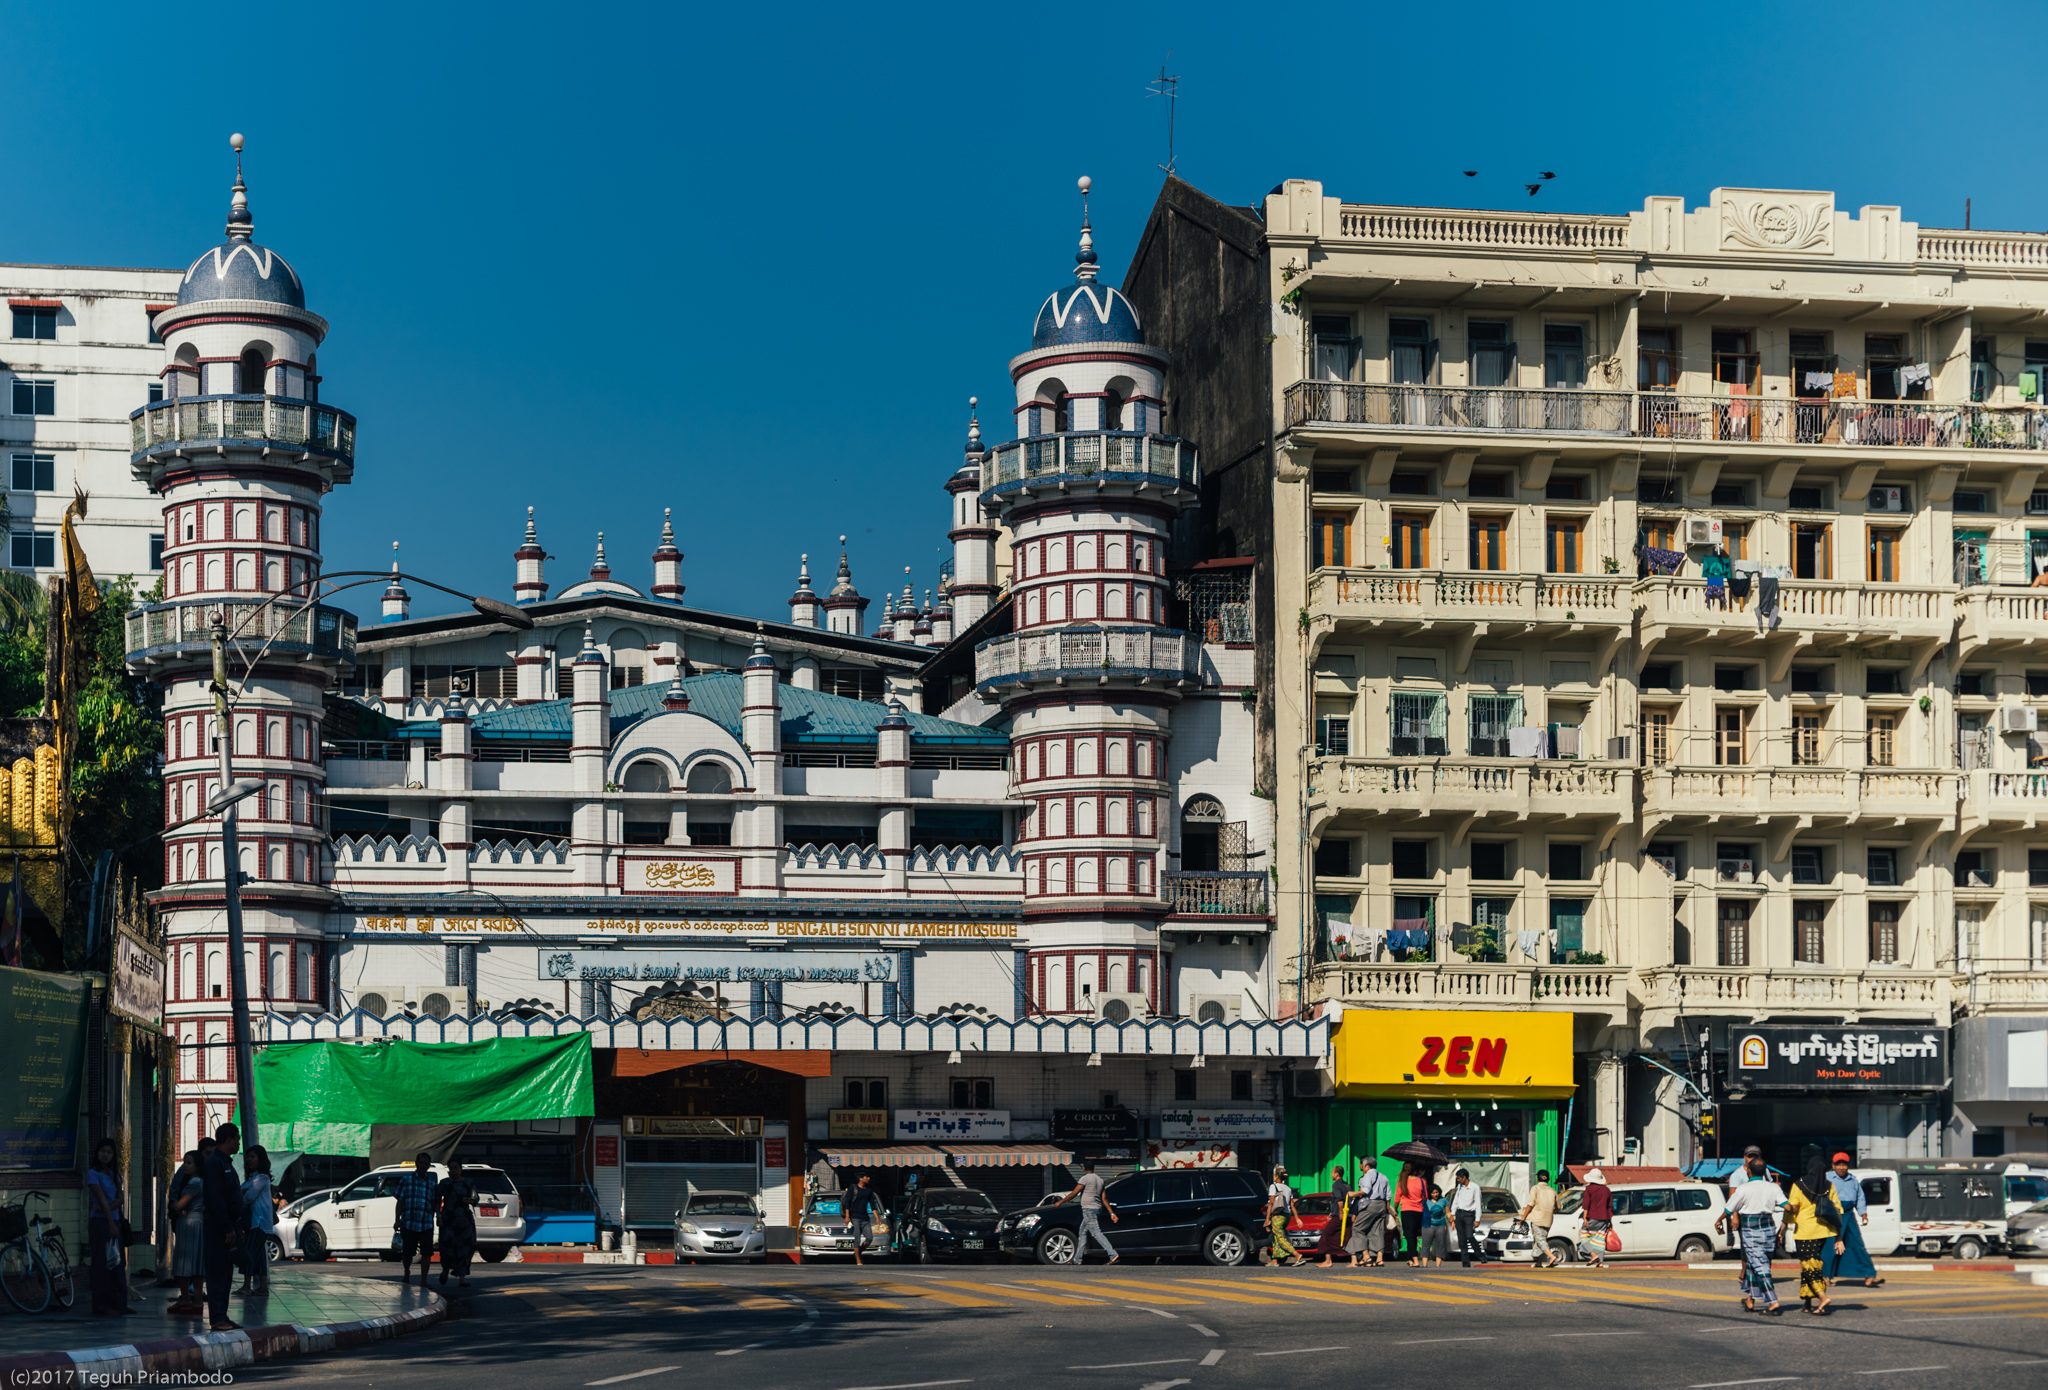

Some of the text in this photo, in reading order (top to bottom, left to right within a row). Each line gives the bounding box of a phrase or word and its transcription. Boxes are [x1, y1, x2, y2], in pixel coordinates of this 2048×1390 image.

[777, 921, 846, 936] BENGALE
[904, 922, 955, 937] JAMEH
[958, 922, 1018, 937] MOSQUE
[580, 963, 638, 979] BENGALI
[641, 963, 681, 979] SUNNI
[737, 966, 804, 981] (CENTRAL)
[809, 967, 860, 981] MOSQUE
[1416, 1036, 1507, 1078] ZEN
[1816, 1068, 1882, 1080] Myo Daw Optic
